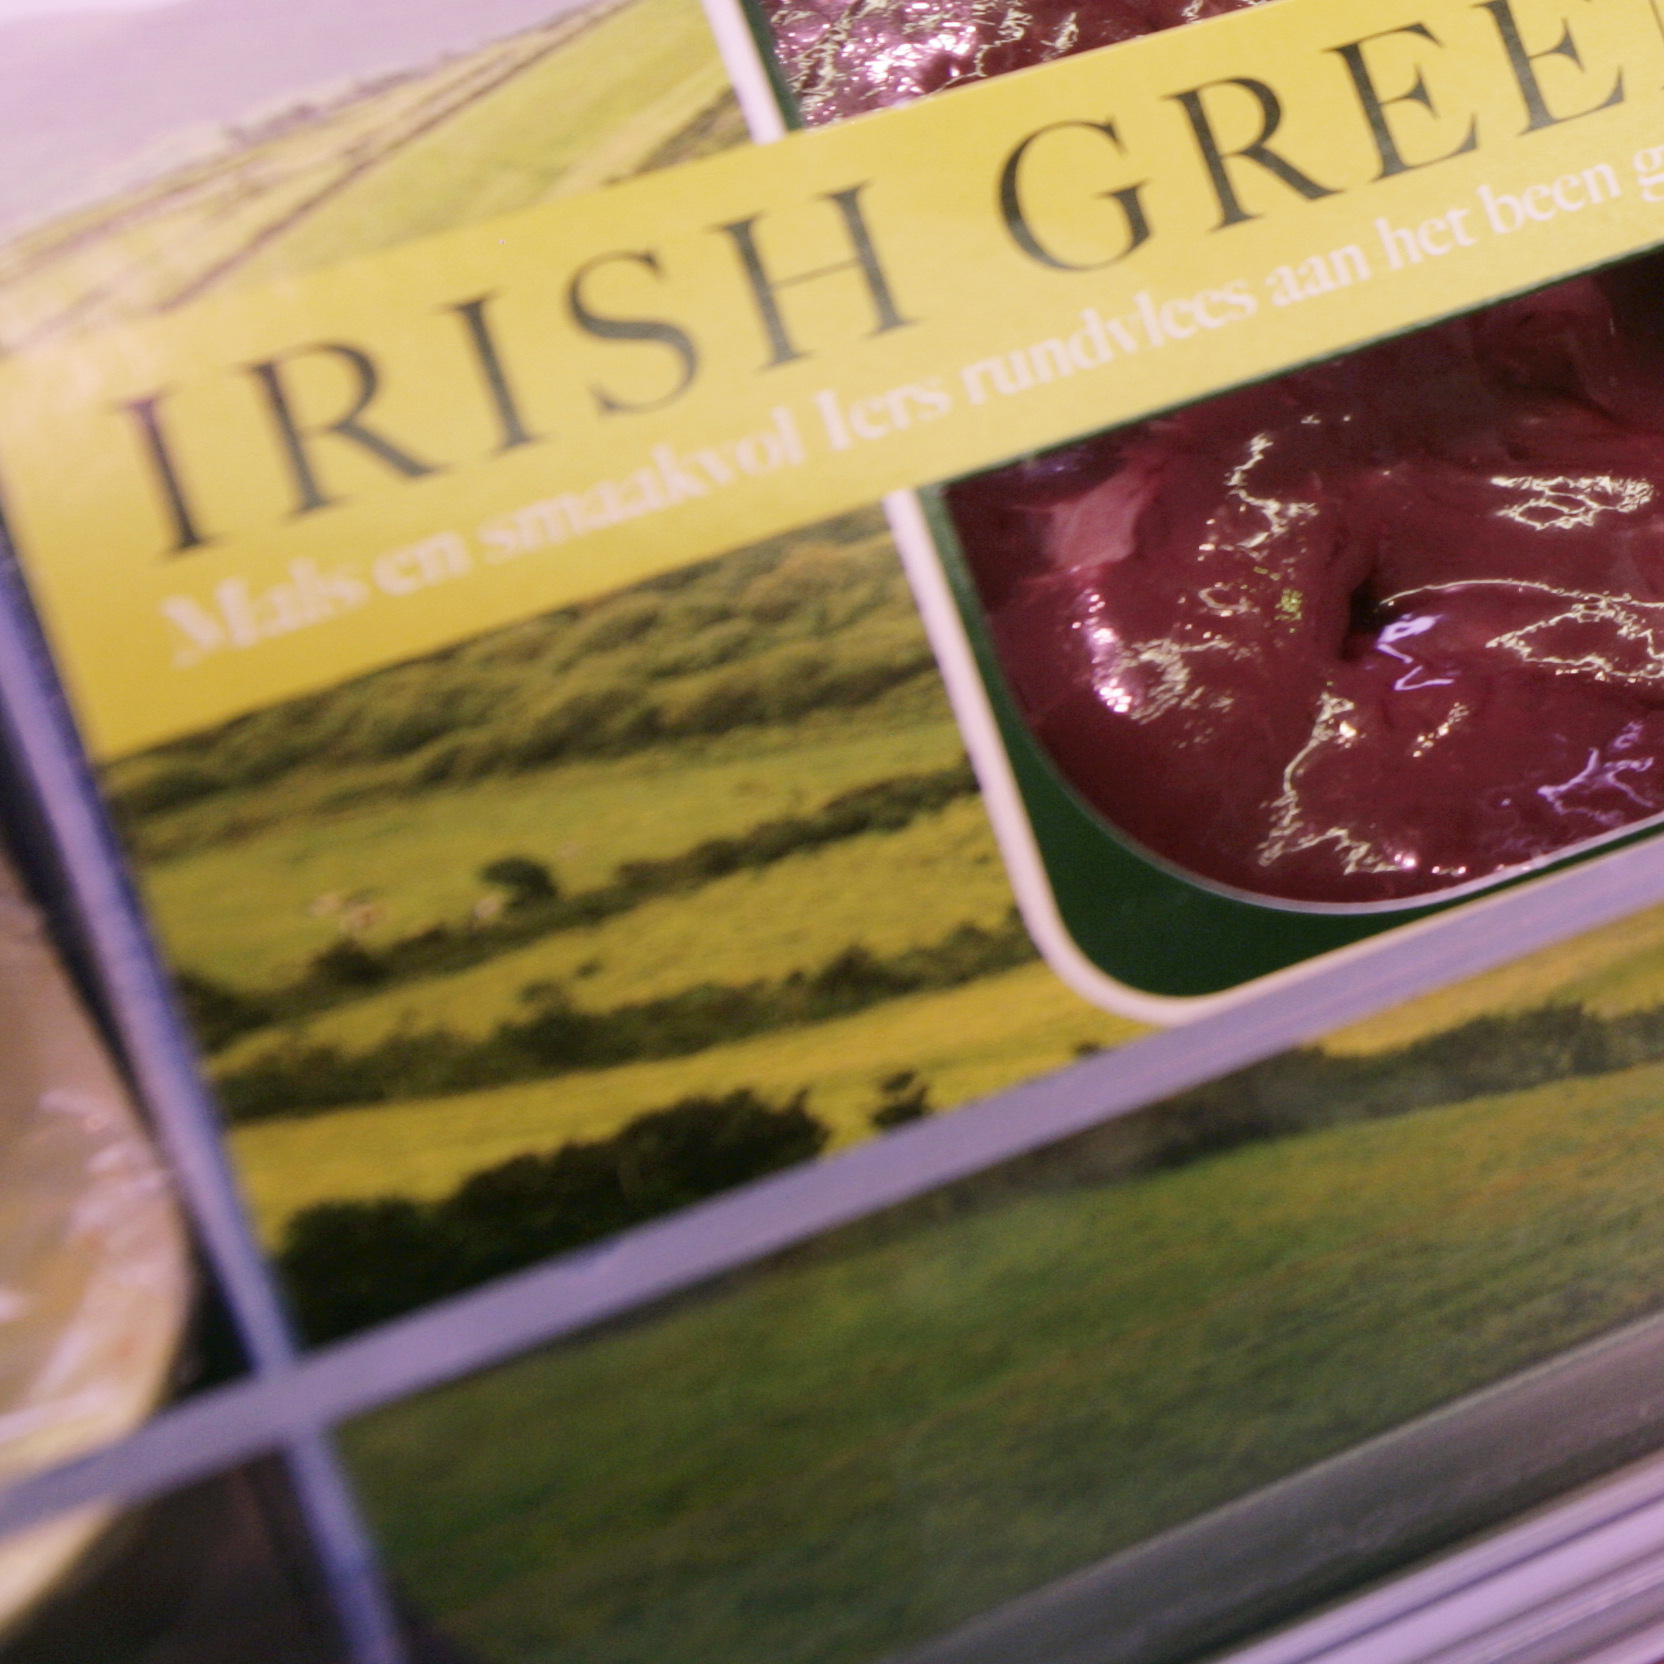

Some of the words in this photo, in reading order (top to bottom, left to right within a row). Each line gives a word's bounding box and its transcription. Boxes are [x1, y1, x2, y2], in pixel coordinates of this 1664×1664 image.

[113, 180, 919, 563] IRISH
[160, 556, 372, 669] Mals
[372, 529, 474, 598] en
[474, 404, 809, 559] smaakvol
[816, 363, 952, 454] Iers
[961, 268, 1258, 407] rundvlees
[1267, 242, 1373, 311] aan
[1383, 193, 1478, 265] het
[1477, 153, 1624, 237] been
